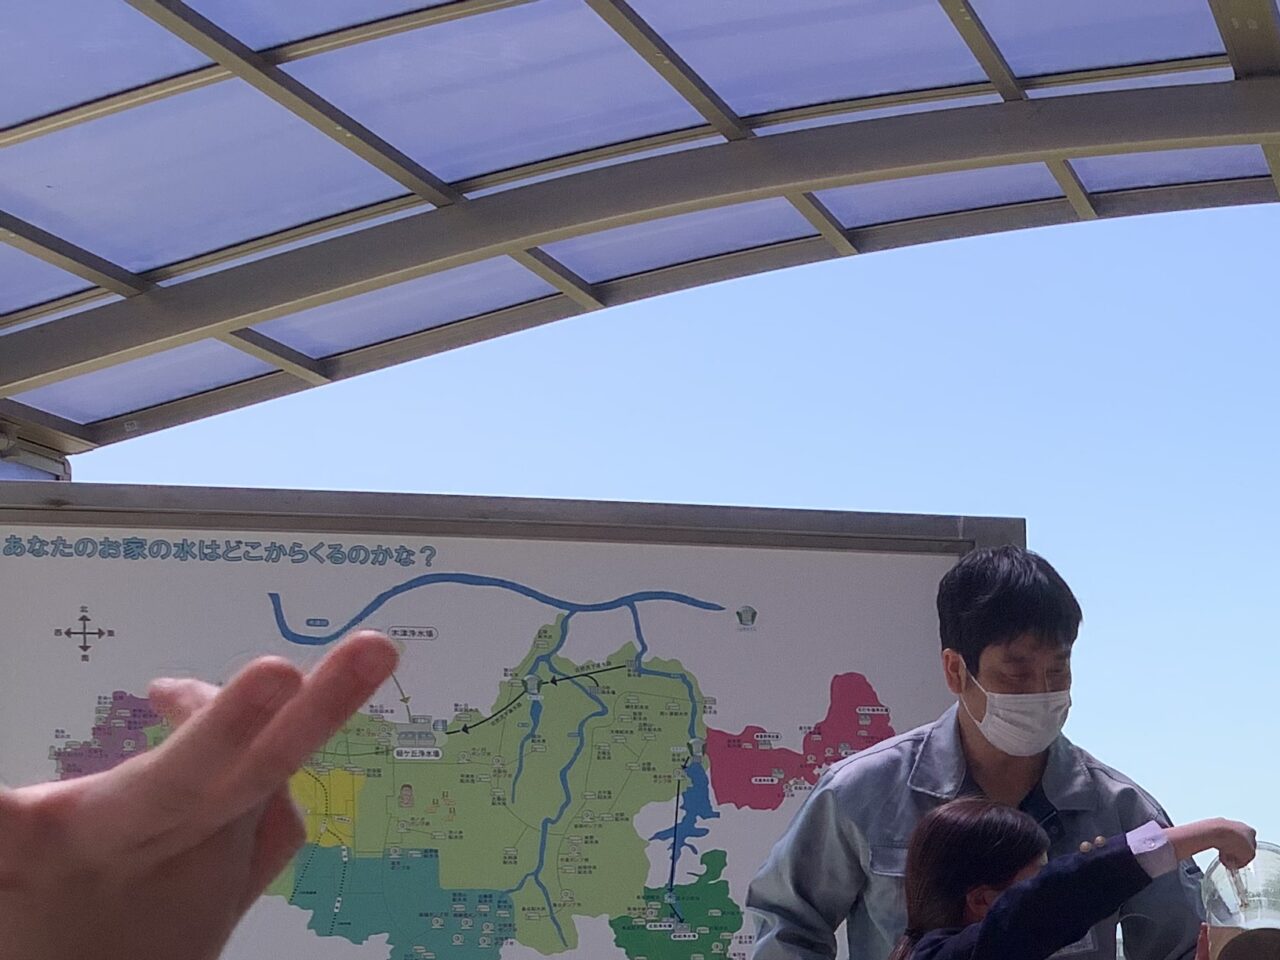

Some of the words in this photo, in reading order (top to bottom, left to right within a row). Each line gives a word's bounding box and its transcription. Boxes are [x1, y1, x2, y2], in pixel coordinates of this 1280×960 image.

[2, 535, 437, 567] あなたのお家の水はどこからくるのかな？
